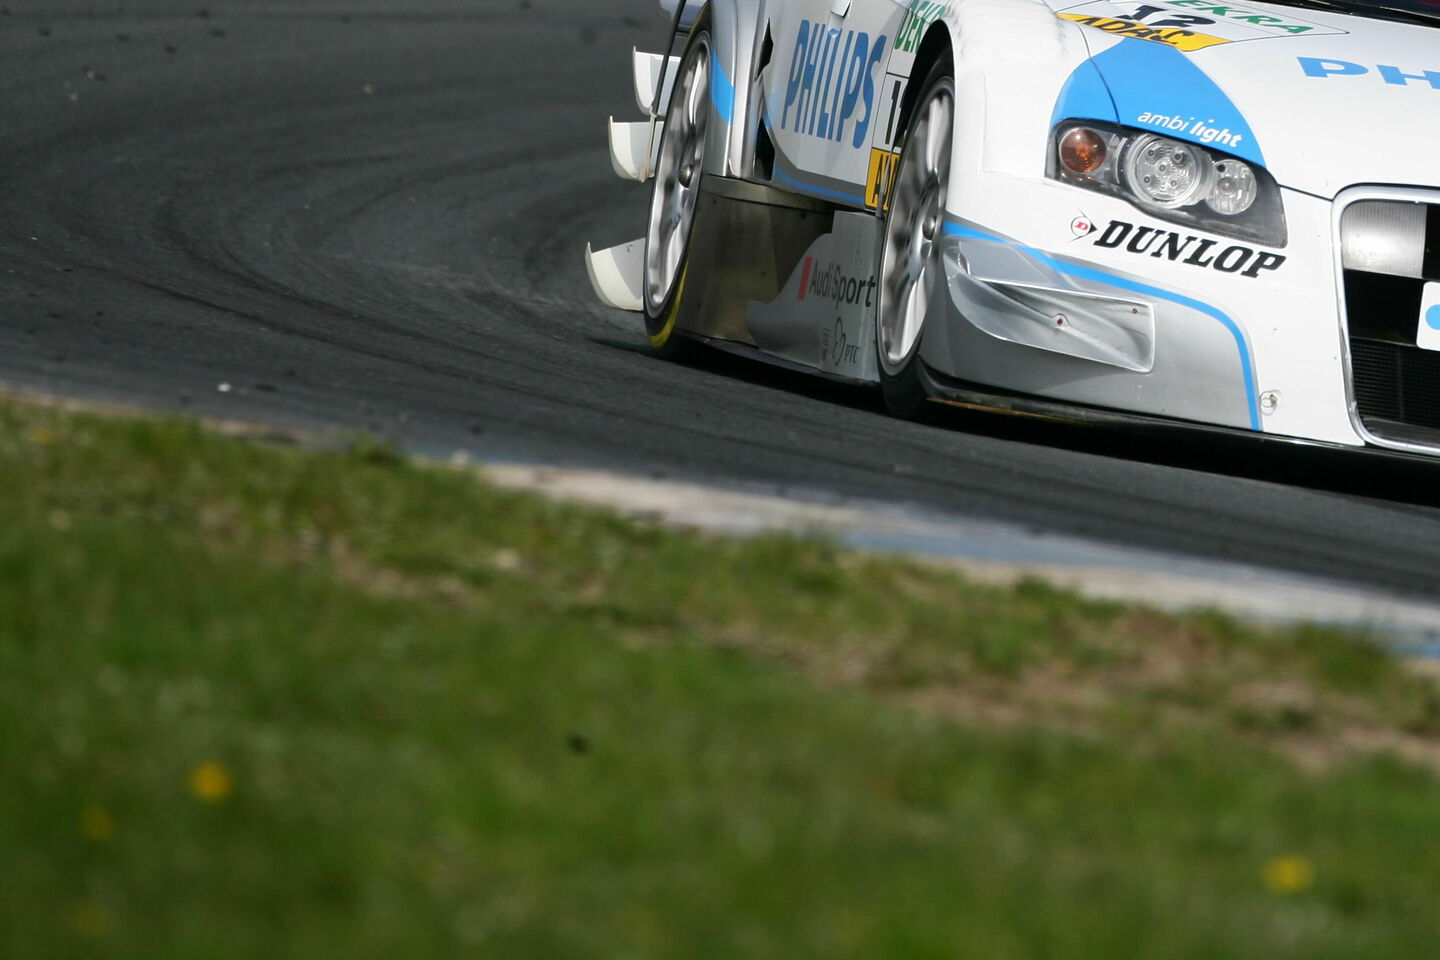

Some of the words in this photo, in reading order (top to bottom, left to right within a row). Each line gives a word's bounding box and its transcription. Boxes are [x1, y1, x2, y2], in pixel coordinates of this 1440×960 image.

[1115, 4, 1217, 29] 12
[780, 19, 887, 149] PHILIPS
[1137, 111, 1195, 132] ambi
[1188, 119, 1243, 148] light
[1093, 219, 1287, 279] DUNLOP
